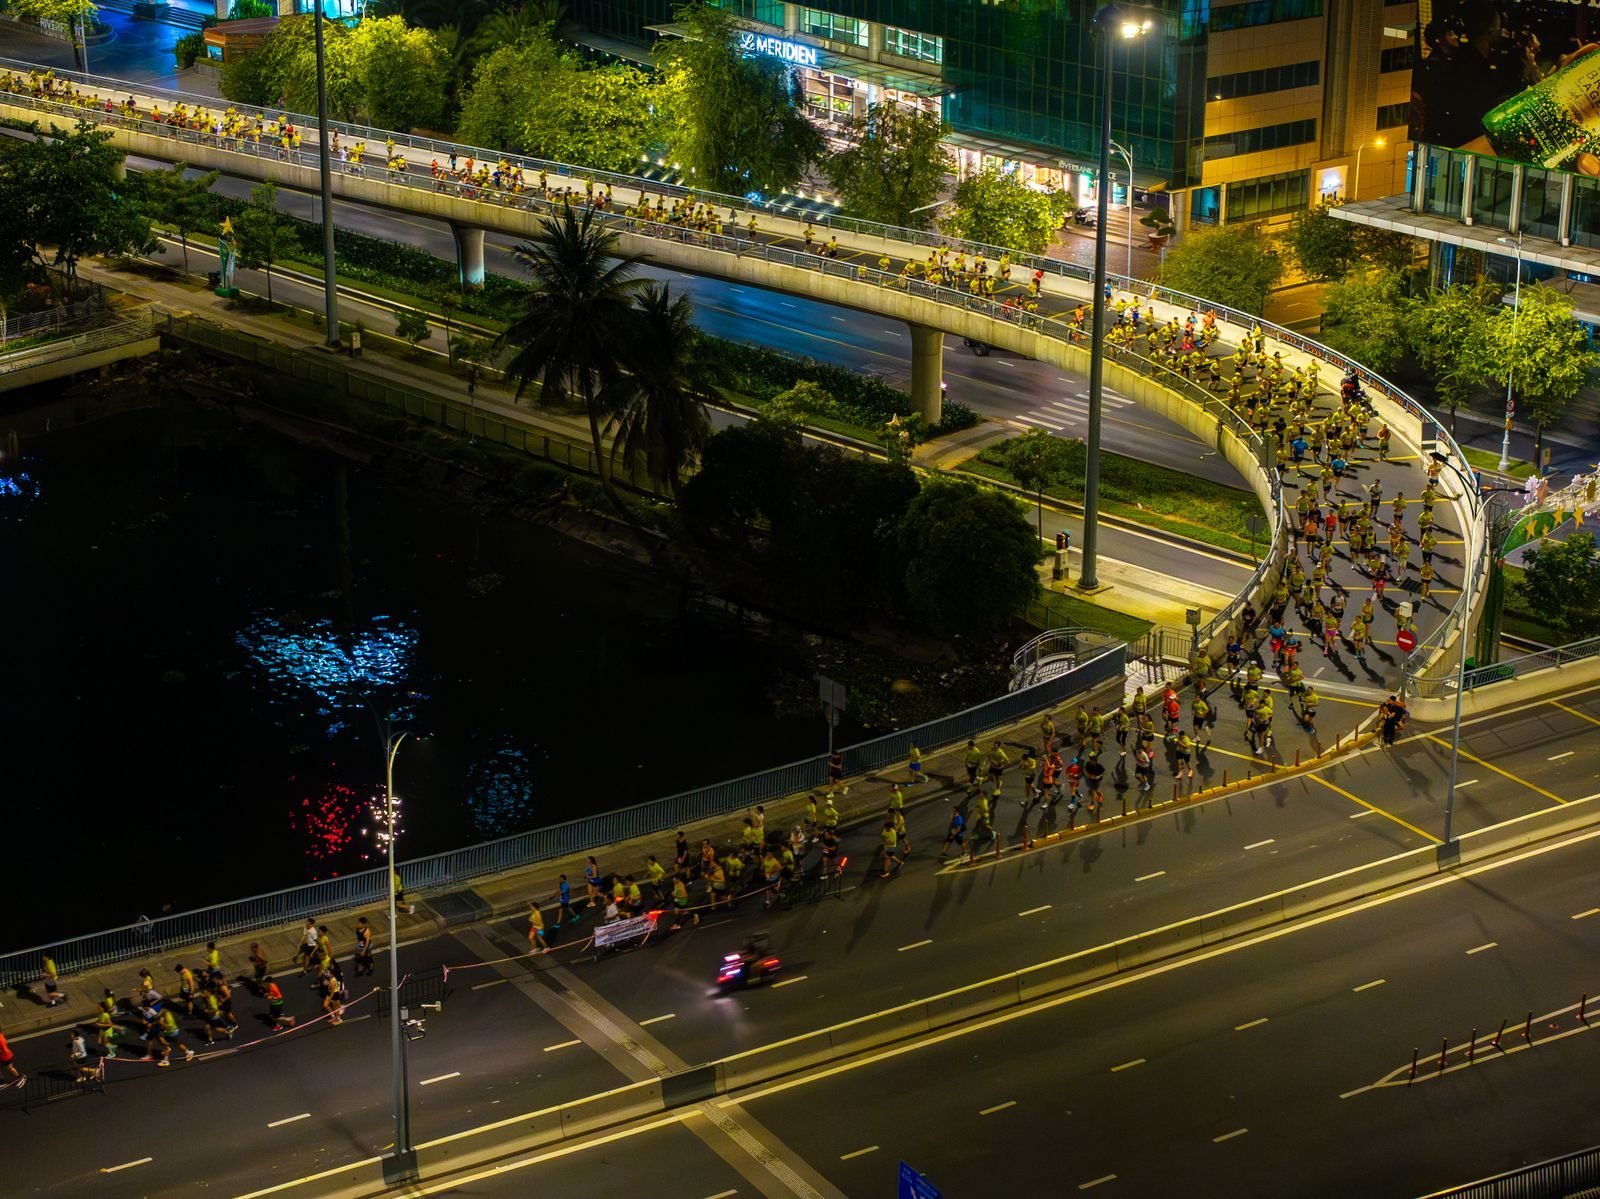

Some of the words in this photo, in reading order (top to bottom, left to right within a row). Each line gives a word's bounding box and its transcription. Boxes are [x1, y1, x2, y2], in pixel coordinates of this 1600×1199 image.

[740, 33, 755, 50] Le
[756, 36, 816, 65] MERIDIEN
[1058, 159, 1093, 174] RIVERBANK
[1096, 169, 1117, 180] PCE
